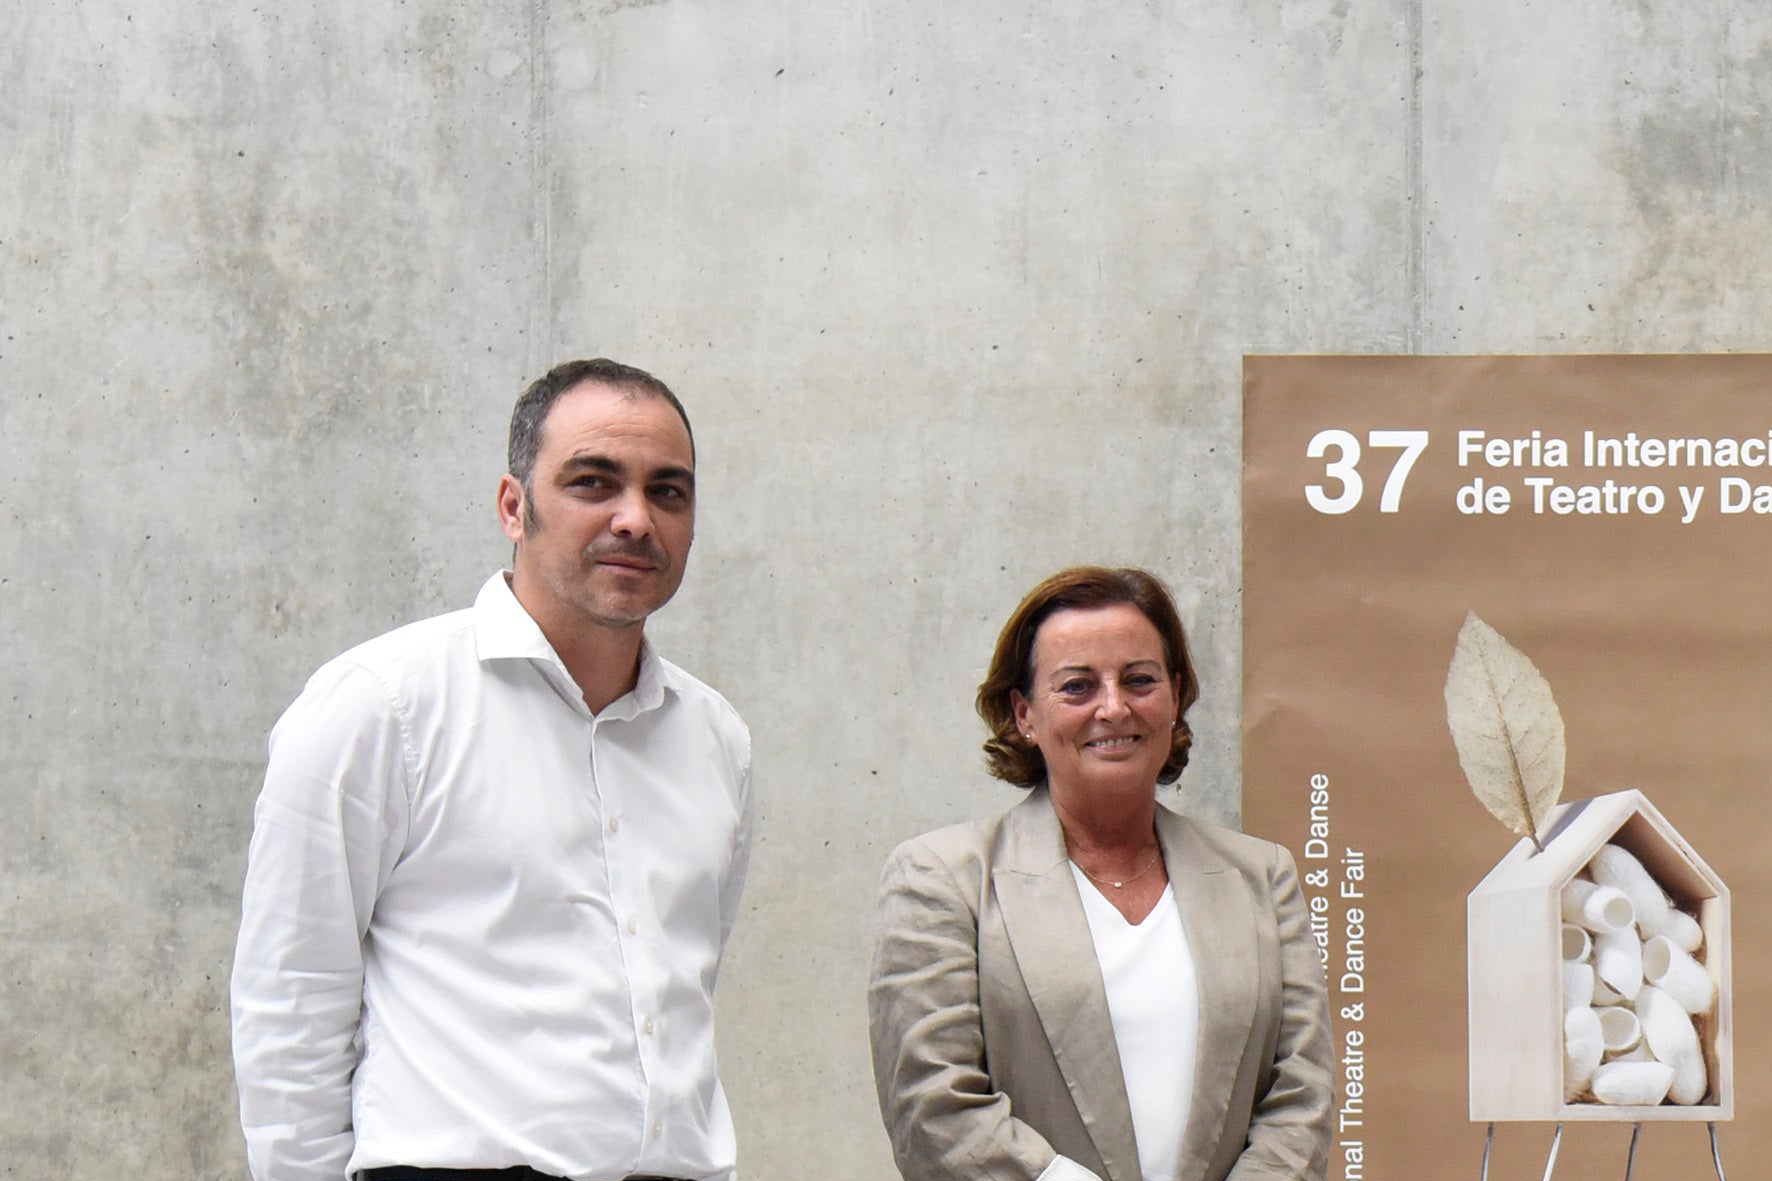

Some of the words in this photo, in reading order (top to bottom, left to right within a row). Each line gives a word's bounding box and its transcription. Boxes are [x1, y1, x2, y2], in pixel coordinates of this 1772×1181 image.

[1304, 429, 1429, 515] 37
[1458, 430, 1569, 468] Feria
[1456, 477, 1511, 515] de
[1523, 477, 1665, 515] Teatro
[1678, 486, 1705, 524] y
[1304, 773, 1329, 858] Danse
[1304, 868, 1329, 888] &
[1340, 847, 1365, 898] Fair
[1340, 907, 1365, 993] Dance
[1340, 1002, 1365, 1022] &
[1339, 1031, 1365, 1132] Theatre
